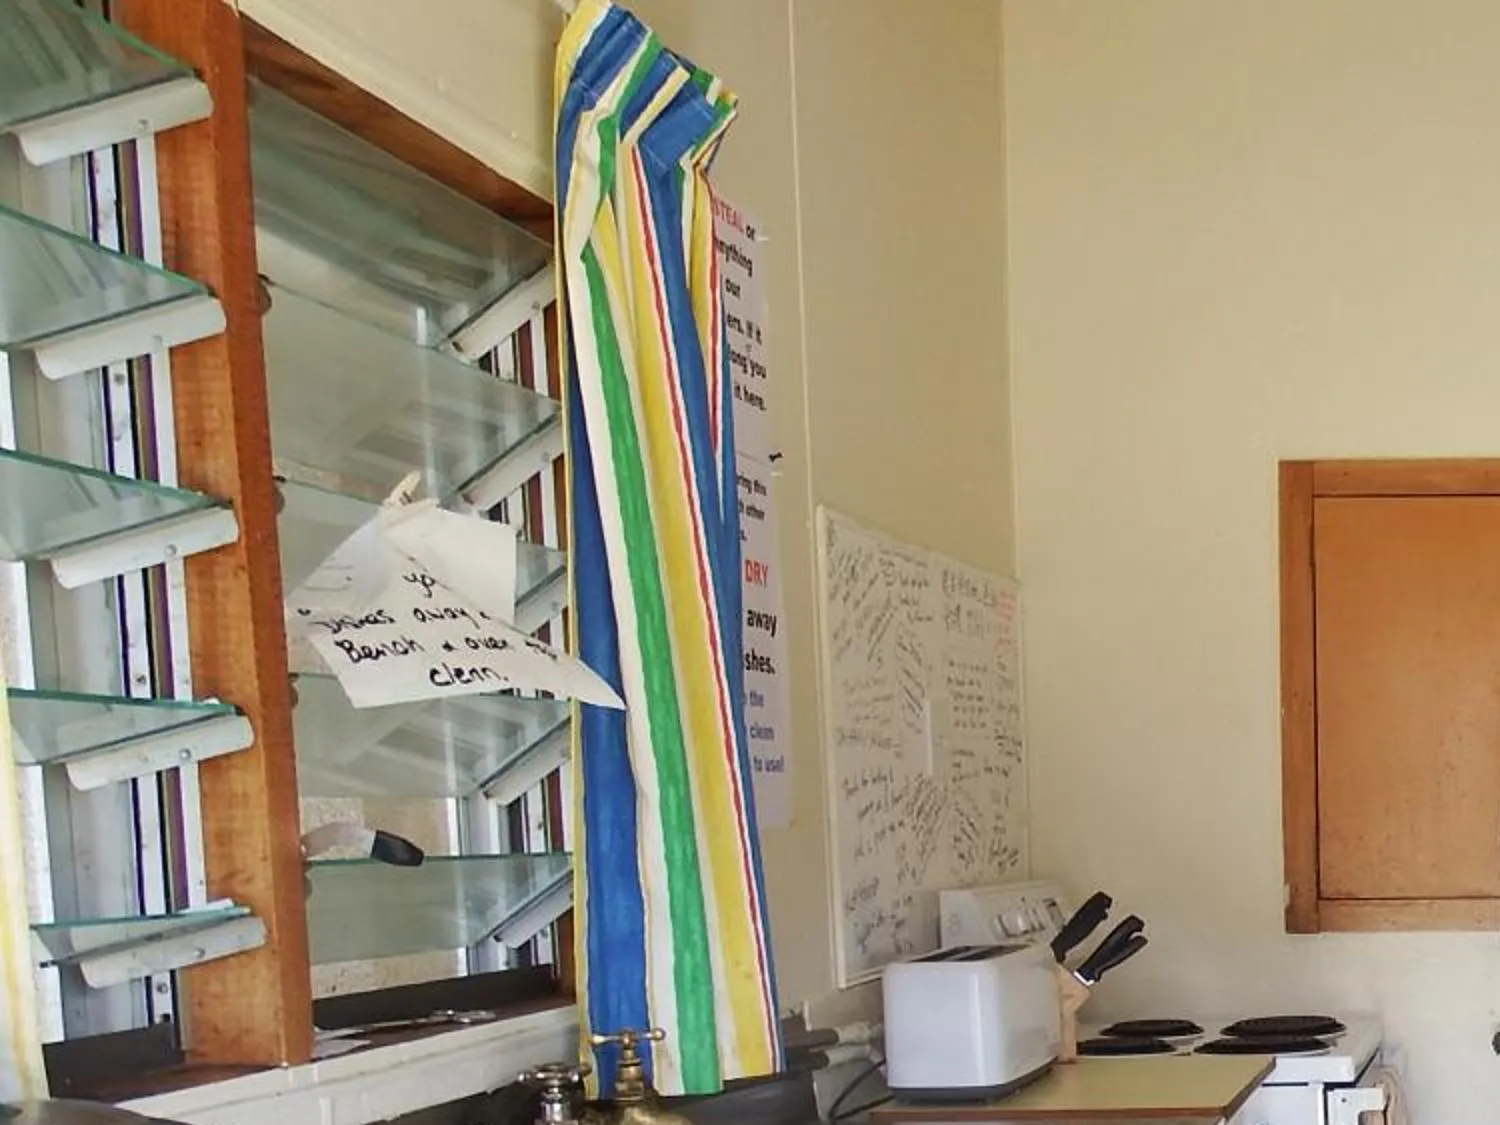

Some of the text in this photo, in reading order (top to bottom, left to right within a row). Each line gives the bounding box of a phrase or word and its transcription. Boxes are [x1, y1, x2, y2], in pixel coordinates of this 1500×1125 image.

[745, 224, 757, 241] or
[749, 359, 767, 379] you
[744, 558, 769, 590] DRY
[747, 608, 778, 638] away
[333, 635, 425, 664] Bench
